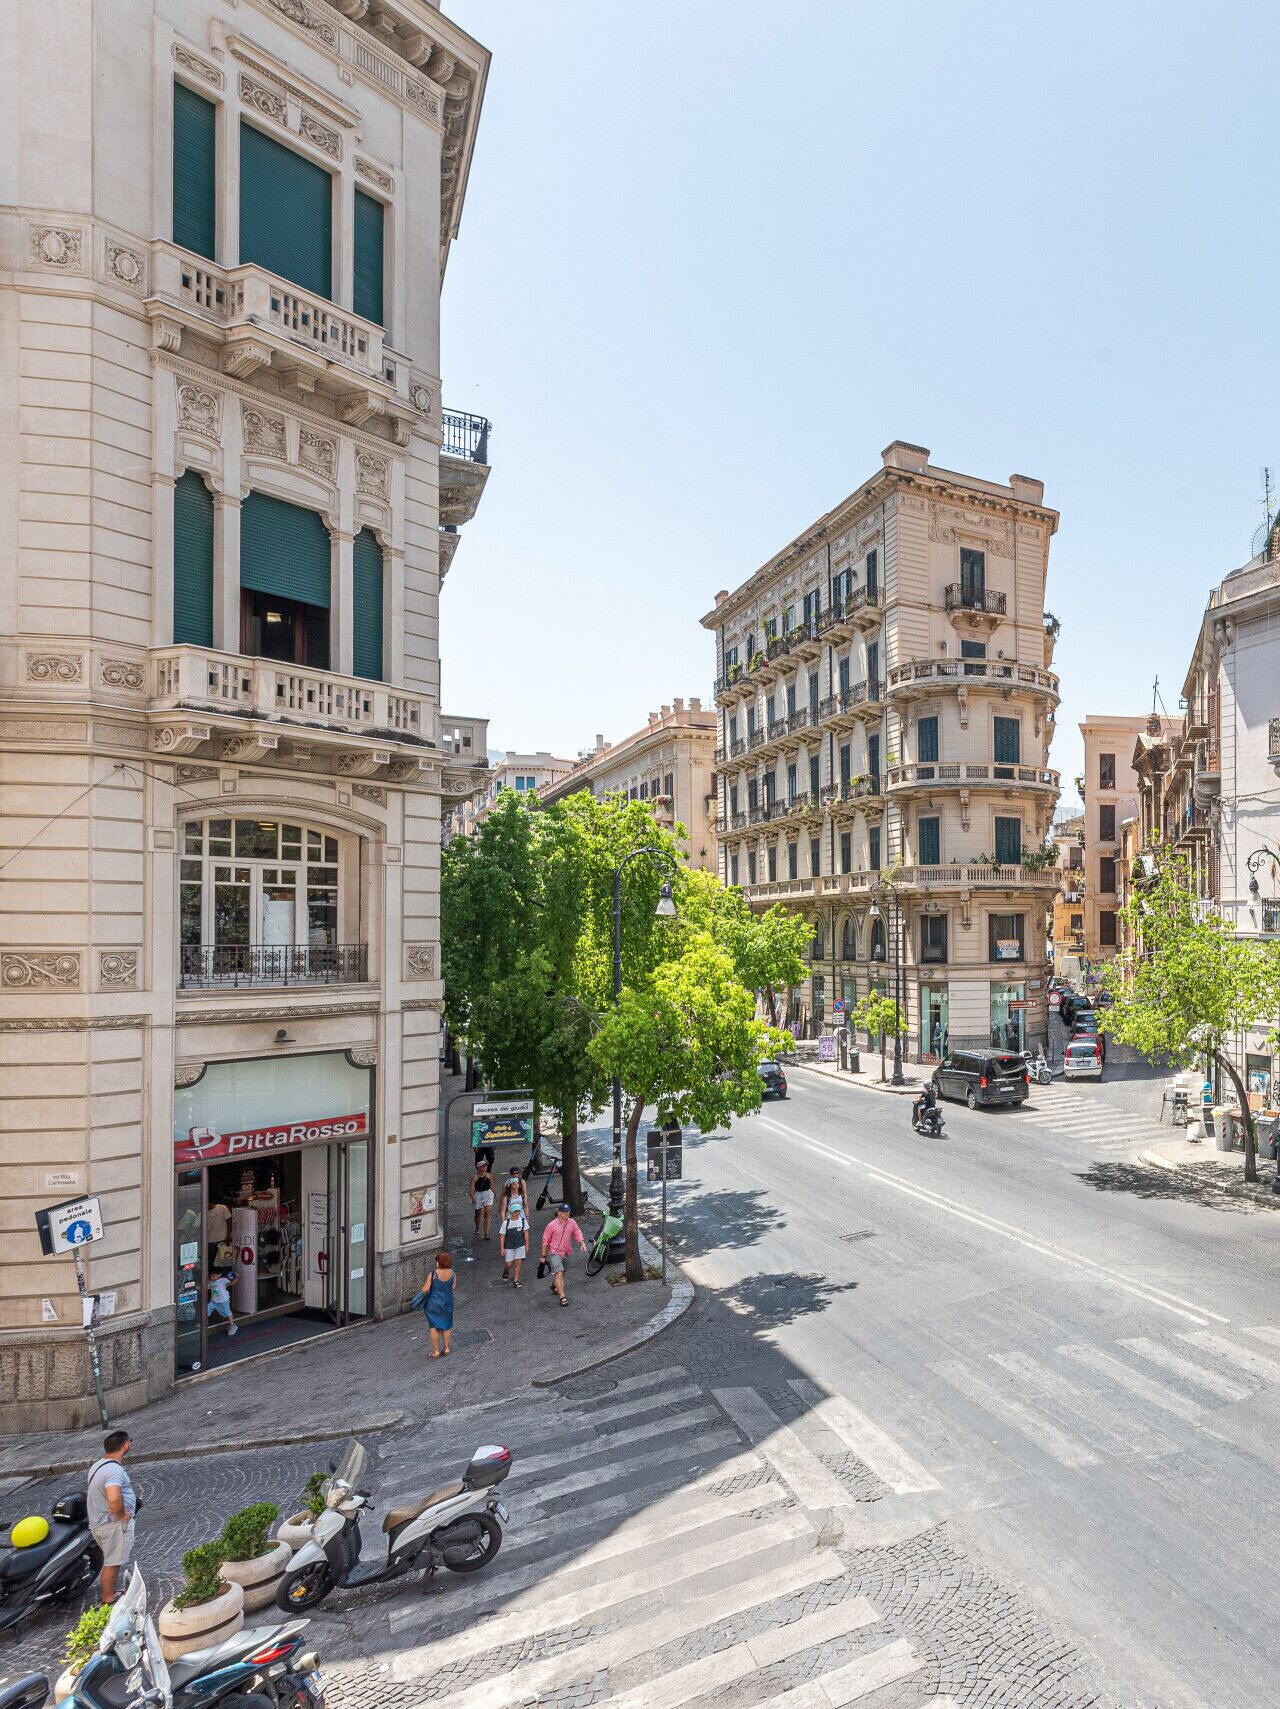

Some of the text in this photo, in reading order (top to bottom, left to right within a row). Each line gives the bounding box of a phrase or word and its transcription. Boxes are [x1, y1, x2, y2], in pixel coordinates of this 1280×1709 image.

[228, 1121, 358, 1153] PittaRosso
[59, 1208, 93, 1225] pedonale
[67, 1205, 83, 1213] area
